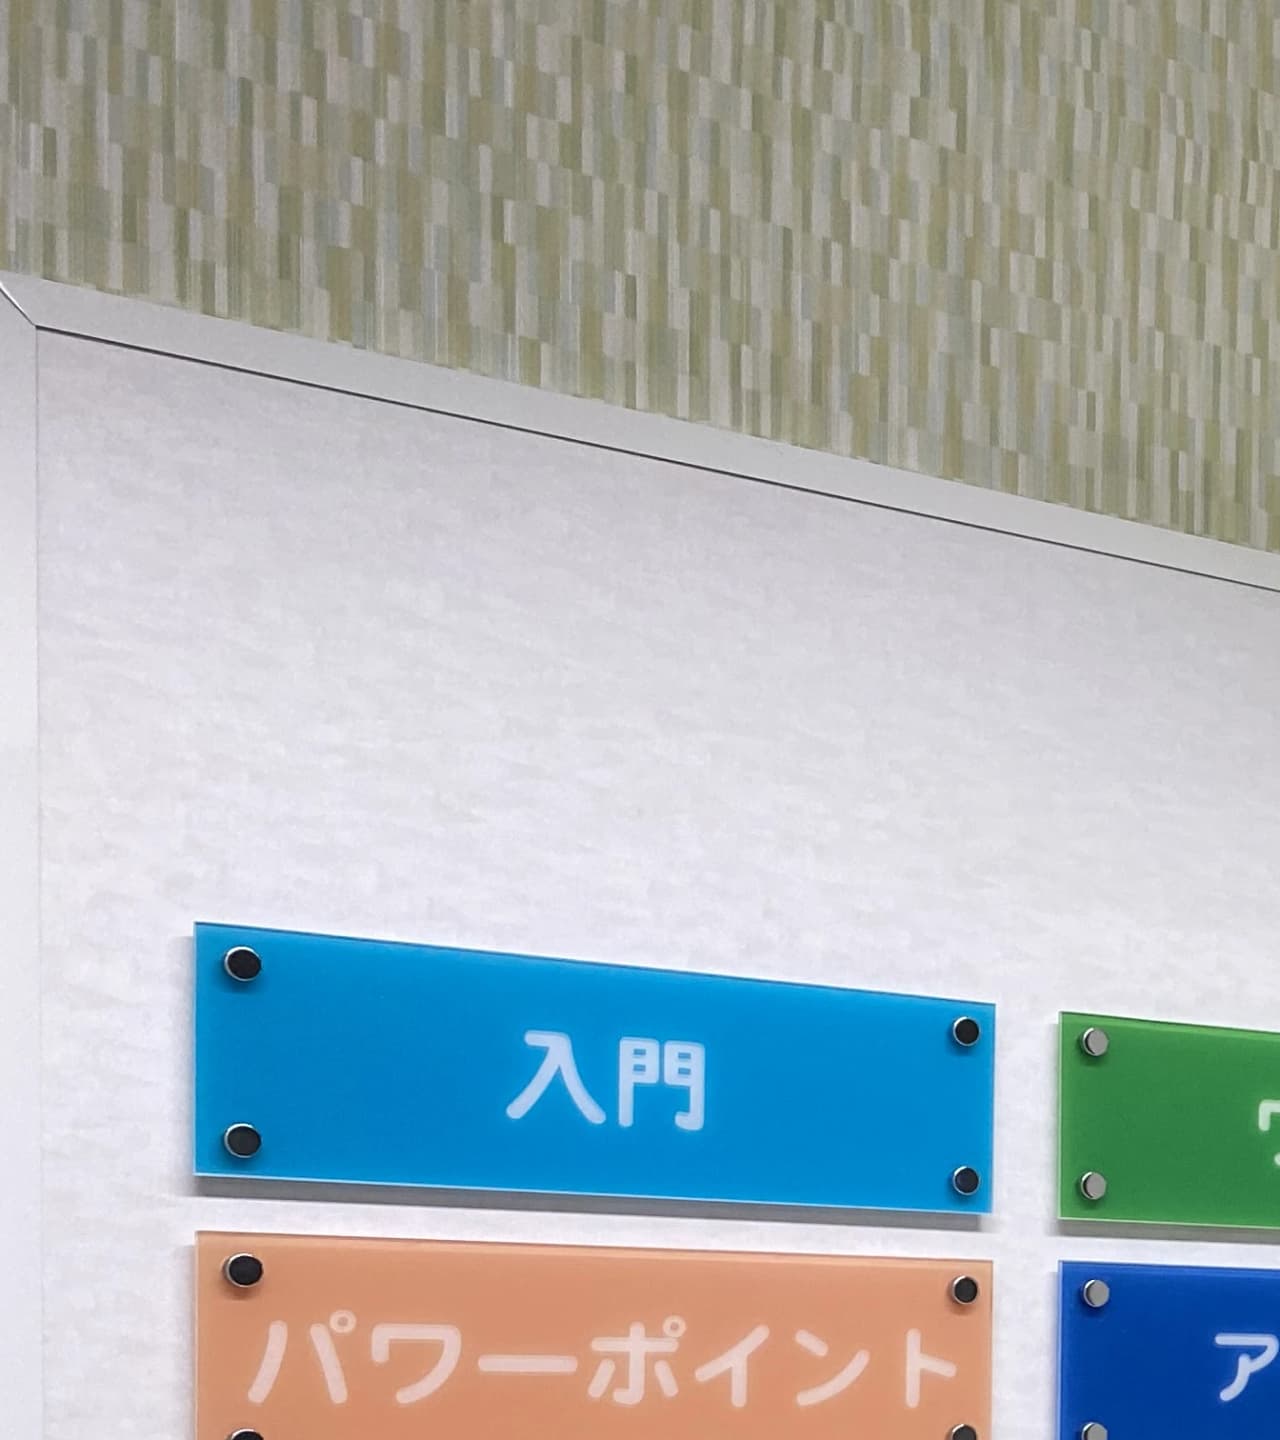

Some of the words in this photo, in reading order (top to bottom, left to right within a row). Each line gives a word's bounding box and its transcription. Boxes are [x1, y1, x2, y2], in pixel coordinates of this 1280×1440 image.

[505, 1029, 706, 1131] 入門
[247, 1309, 957, 1407] パワーポイント
